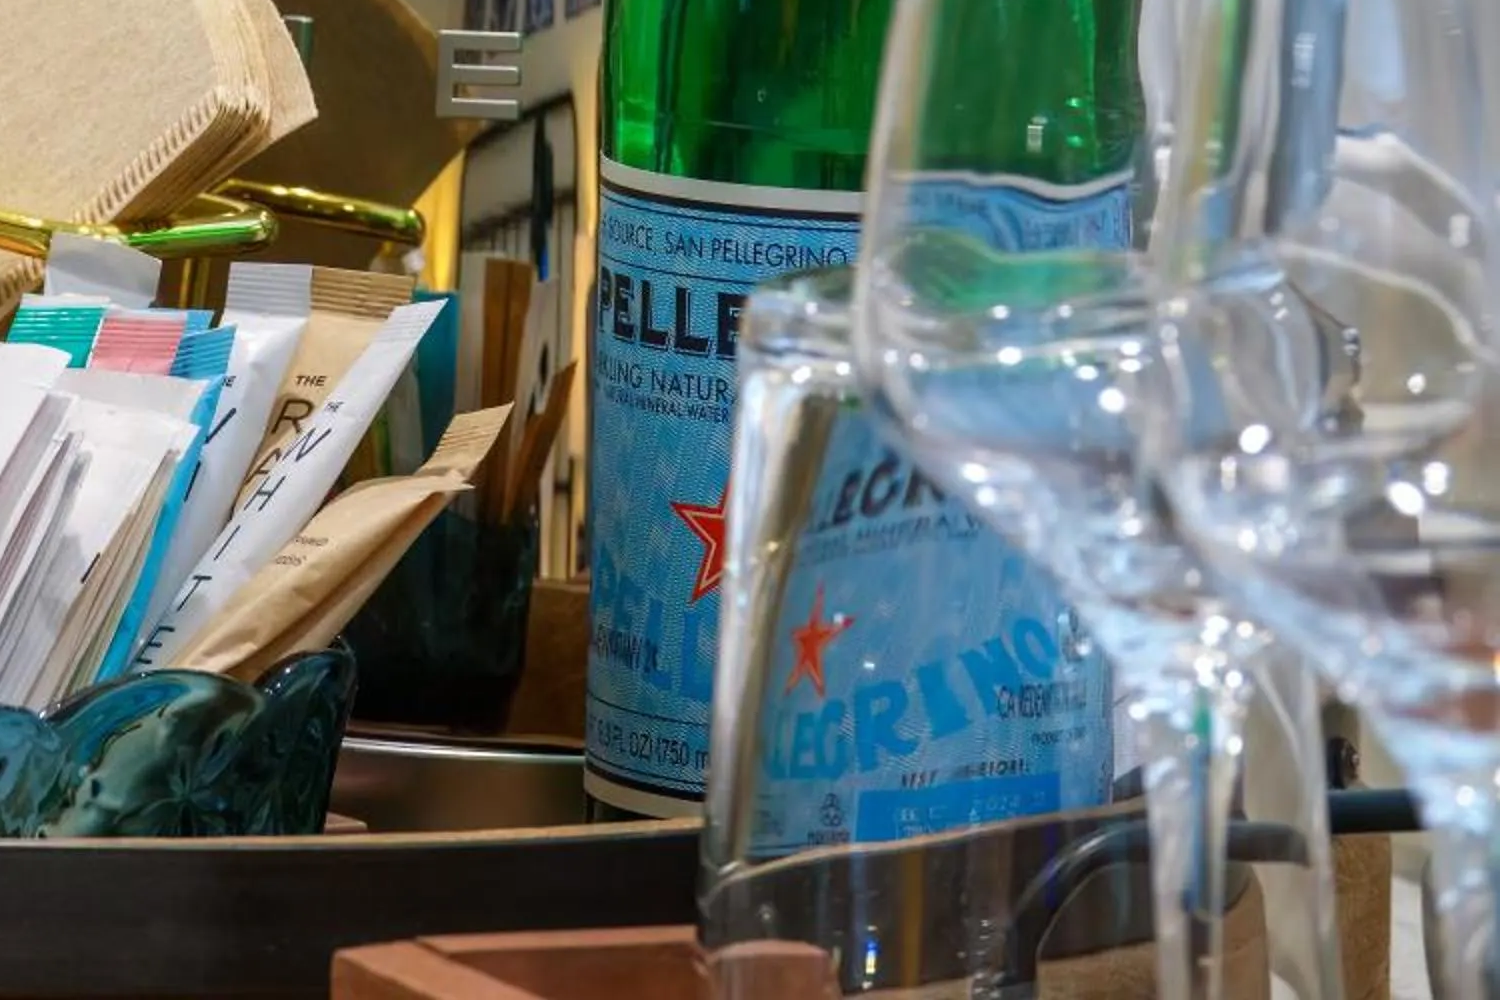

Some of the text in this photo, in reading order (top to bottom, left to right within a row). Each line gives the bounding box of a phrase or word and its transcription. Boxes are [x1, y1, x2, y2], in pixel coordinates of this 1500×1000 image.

[664, 230, 705, 259] SAN
[711, 236, 849, 268] PELLEGRINO
[296, 375, 328, 387] THE
[651, 367, 736, 405] NATUR
